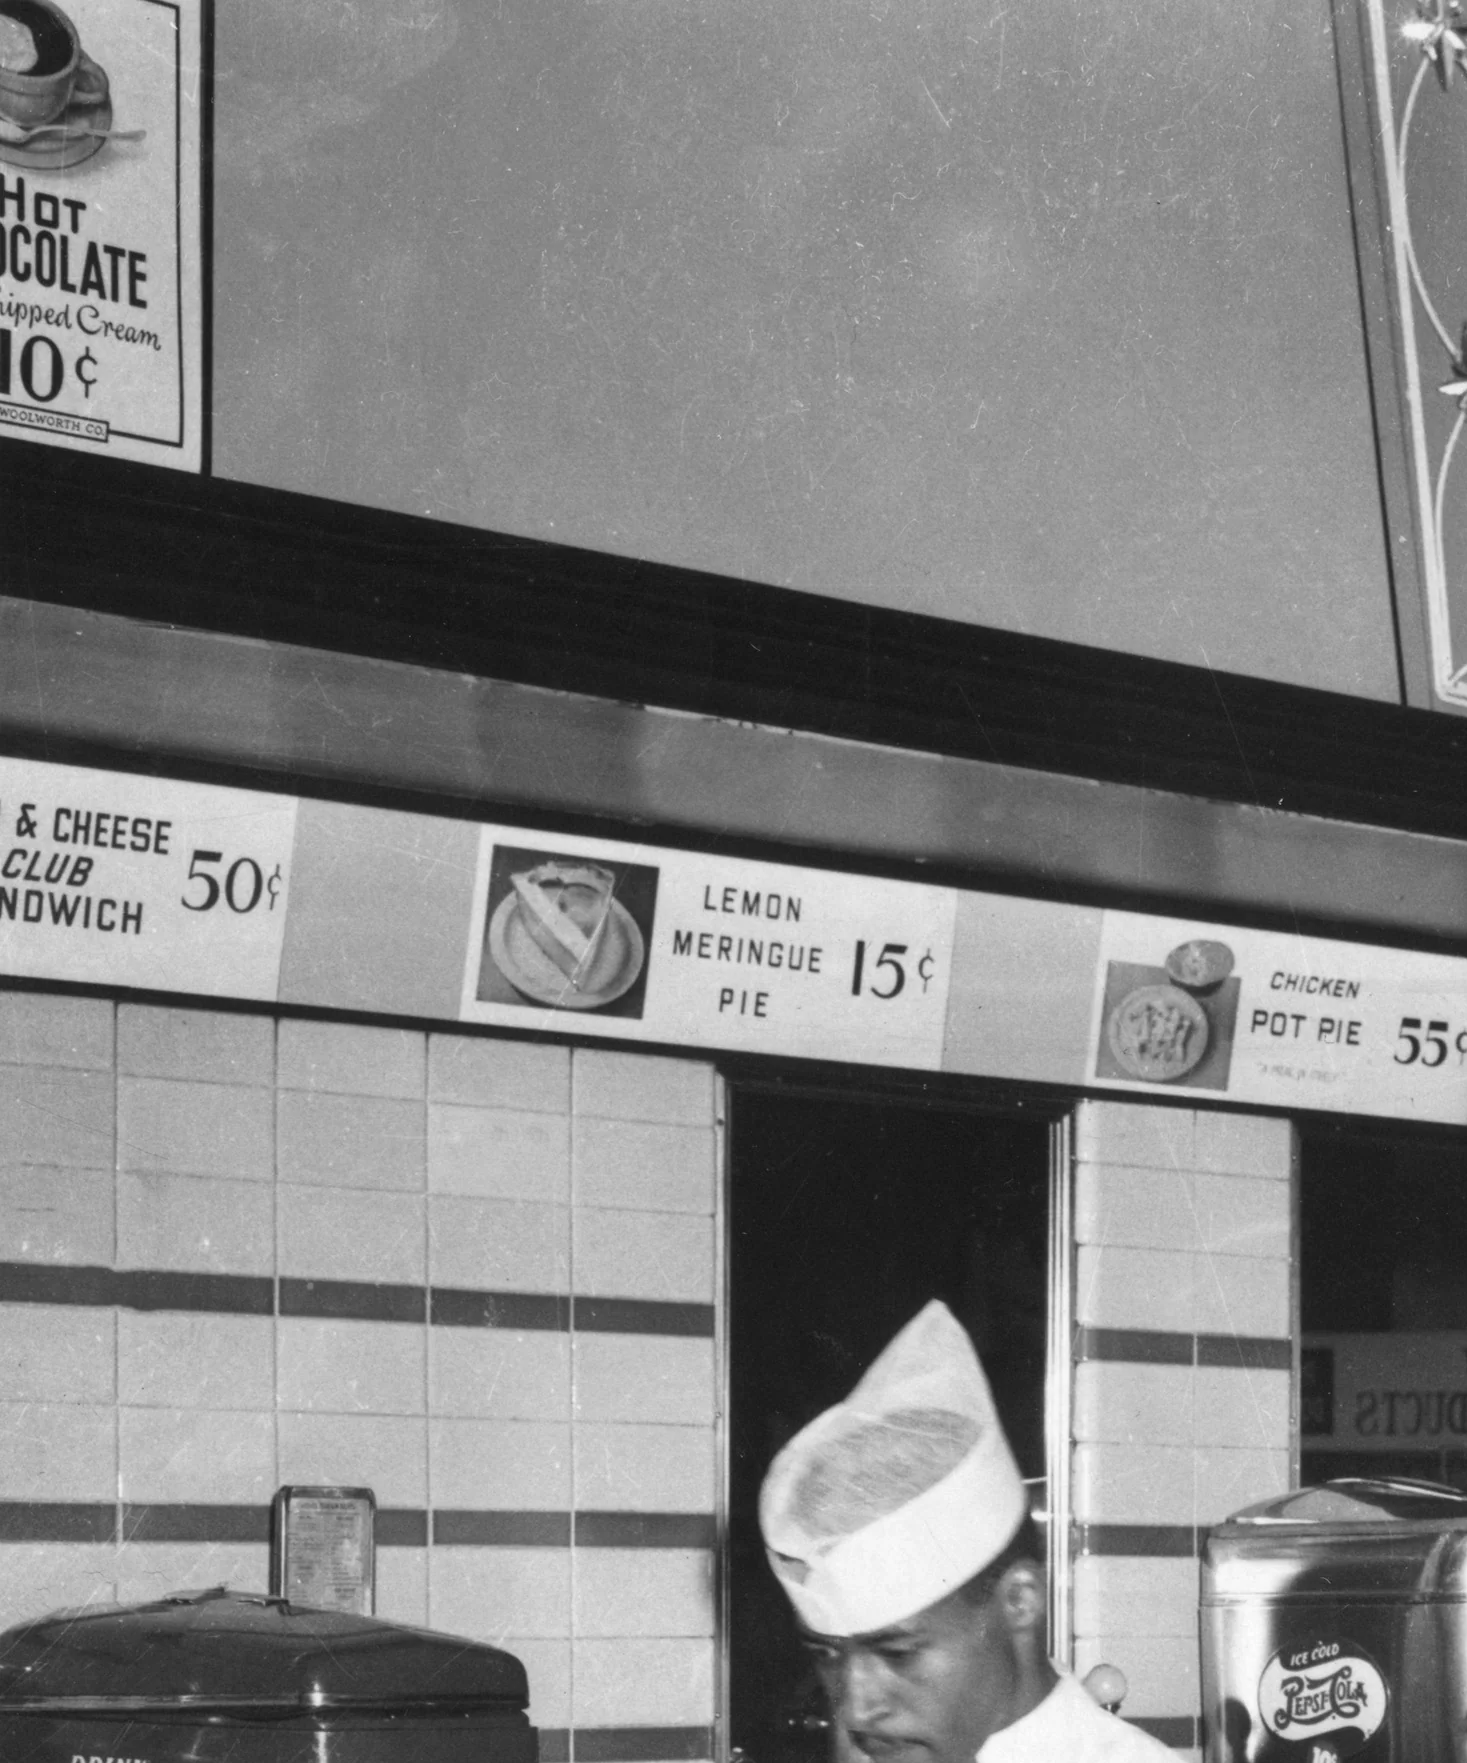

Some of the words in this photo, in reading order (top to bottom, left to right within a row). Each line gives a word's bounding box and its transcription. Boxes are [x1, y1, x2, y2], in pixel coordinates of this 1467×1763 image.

[76, 304, 161, 351] Cream
[0, 328, 98, 402] 10¢
[16, 803, 38, 838] &
[53, 807, 173, 855] CHEESE
[1, 848, 94, 887] CLUB
[181, 850, 282, 914] 50¢
[703, 885, 802, 923] LEMON
[672, 929, 823, 974] MERINGUE
[852, 939, 935, 999] 15¢
[718, 988, 770, 1018] PIE
[1270, 971, 1361, 999] CHICKEN
[1251, 1009, 1306, 1039] POT
[1317, 1017, 1362, 1046] PIE
[1290, 1649, 1310, 1667] ICE
[1312, 1640, 1340, 1661] COLD
